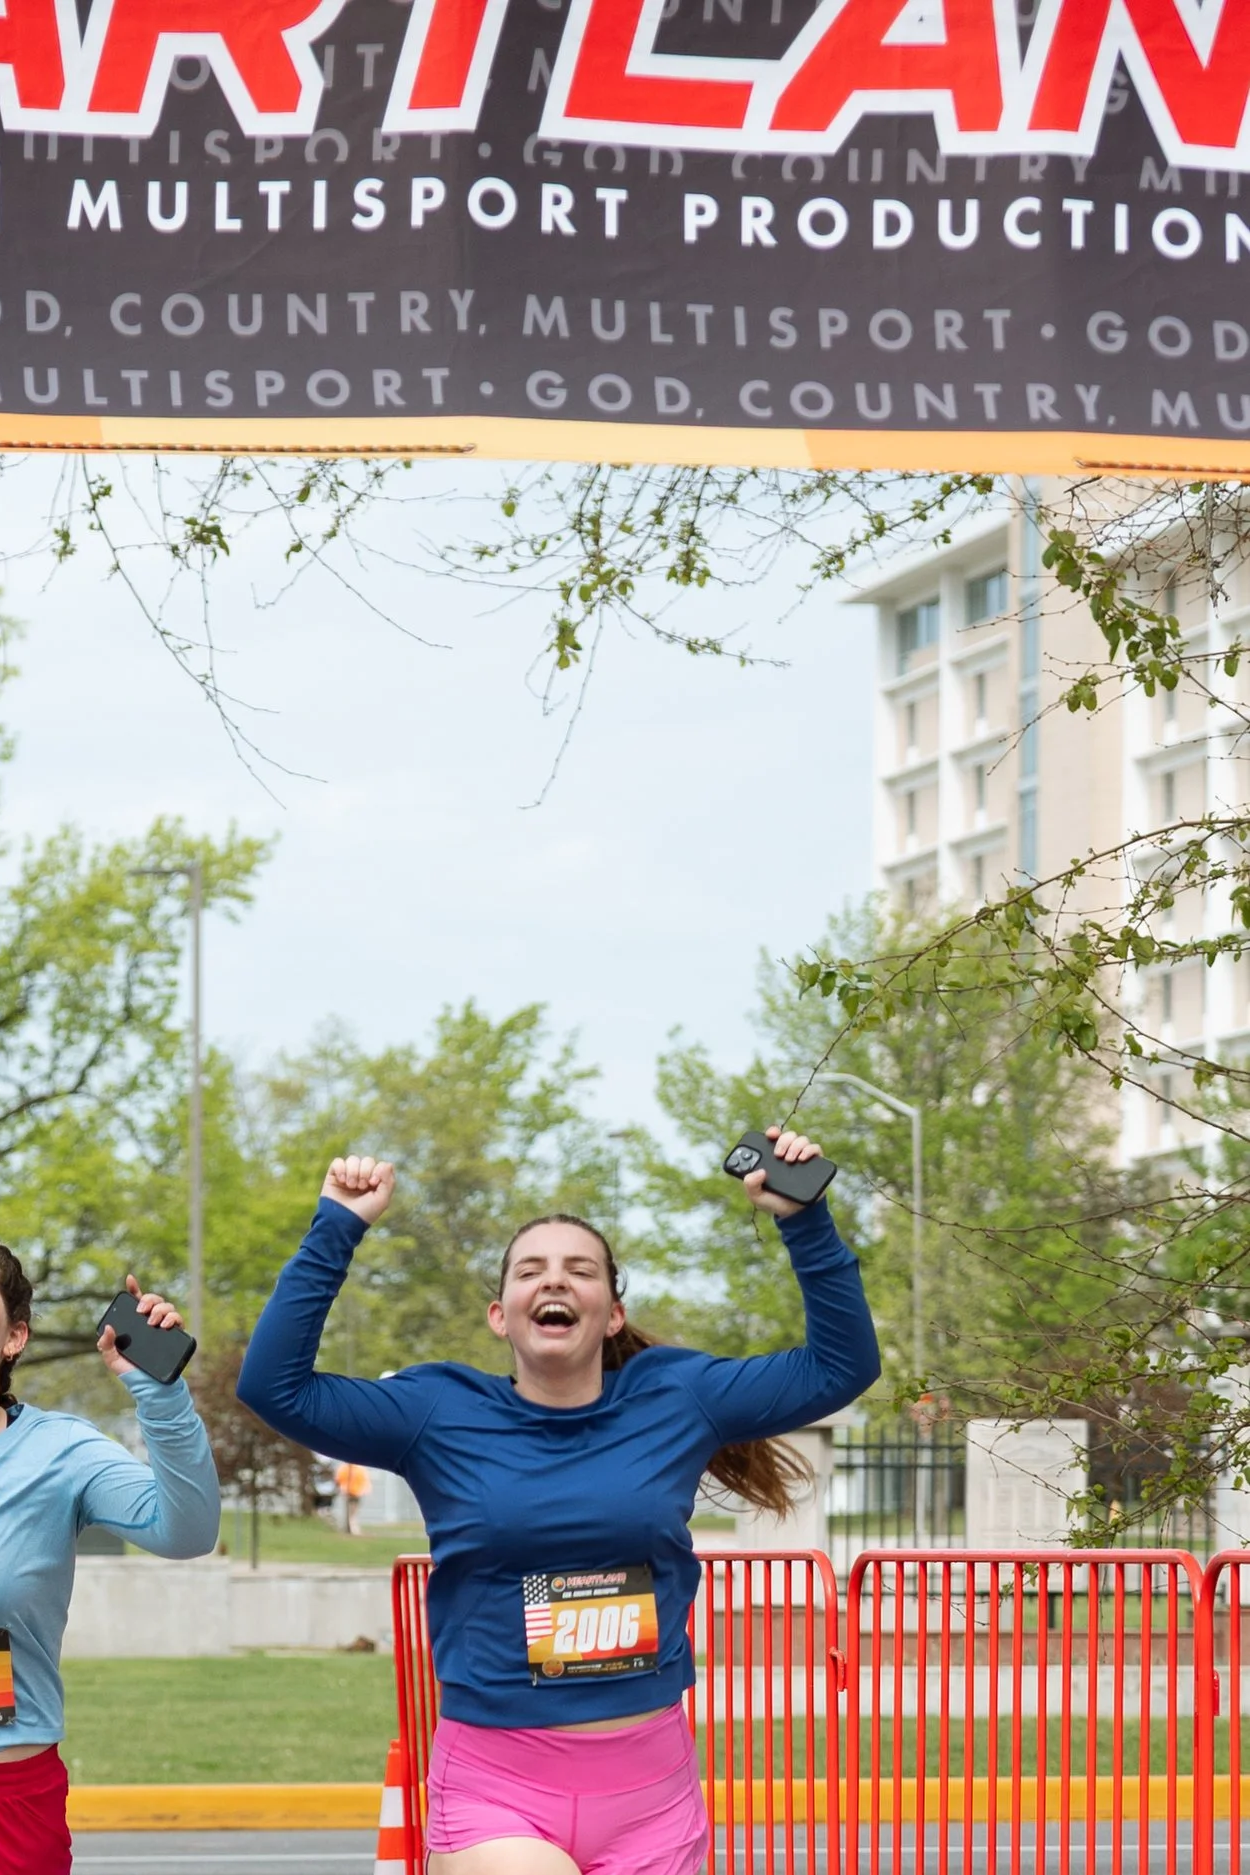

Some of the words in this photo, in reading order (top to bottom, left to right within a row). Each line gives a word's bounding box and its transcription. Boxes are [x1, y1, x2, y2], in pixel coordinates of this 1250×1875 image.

[67, 177, 628, 236] MULTISPORT
[109, 288, 488, 338] COUNTRY,
[523, 295, 1012, 353] MULTISPORT
[525, 371, 705, 420] GOD,
[738, 379, 1117, 428] COUNTRY,
[553, 1603, 640, 1655] 2006
